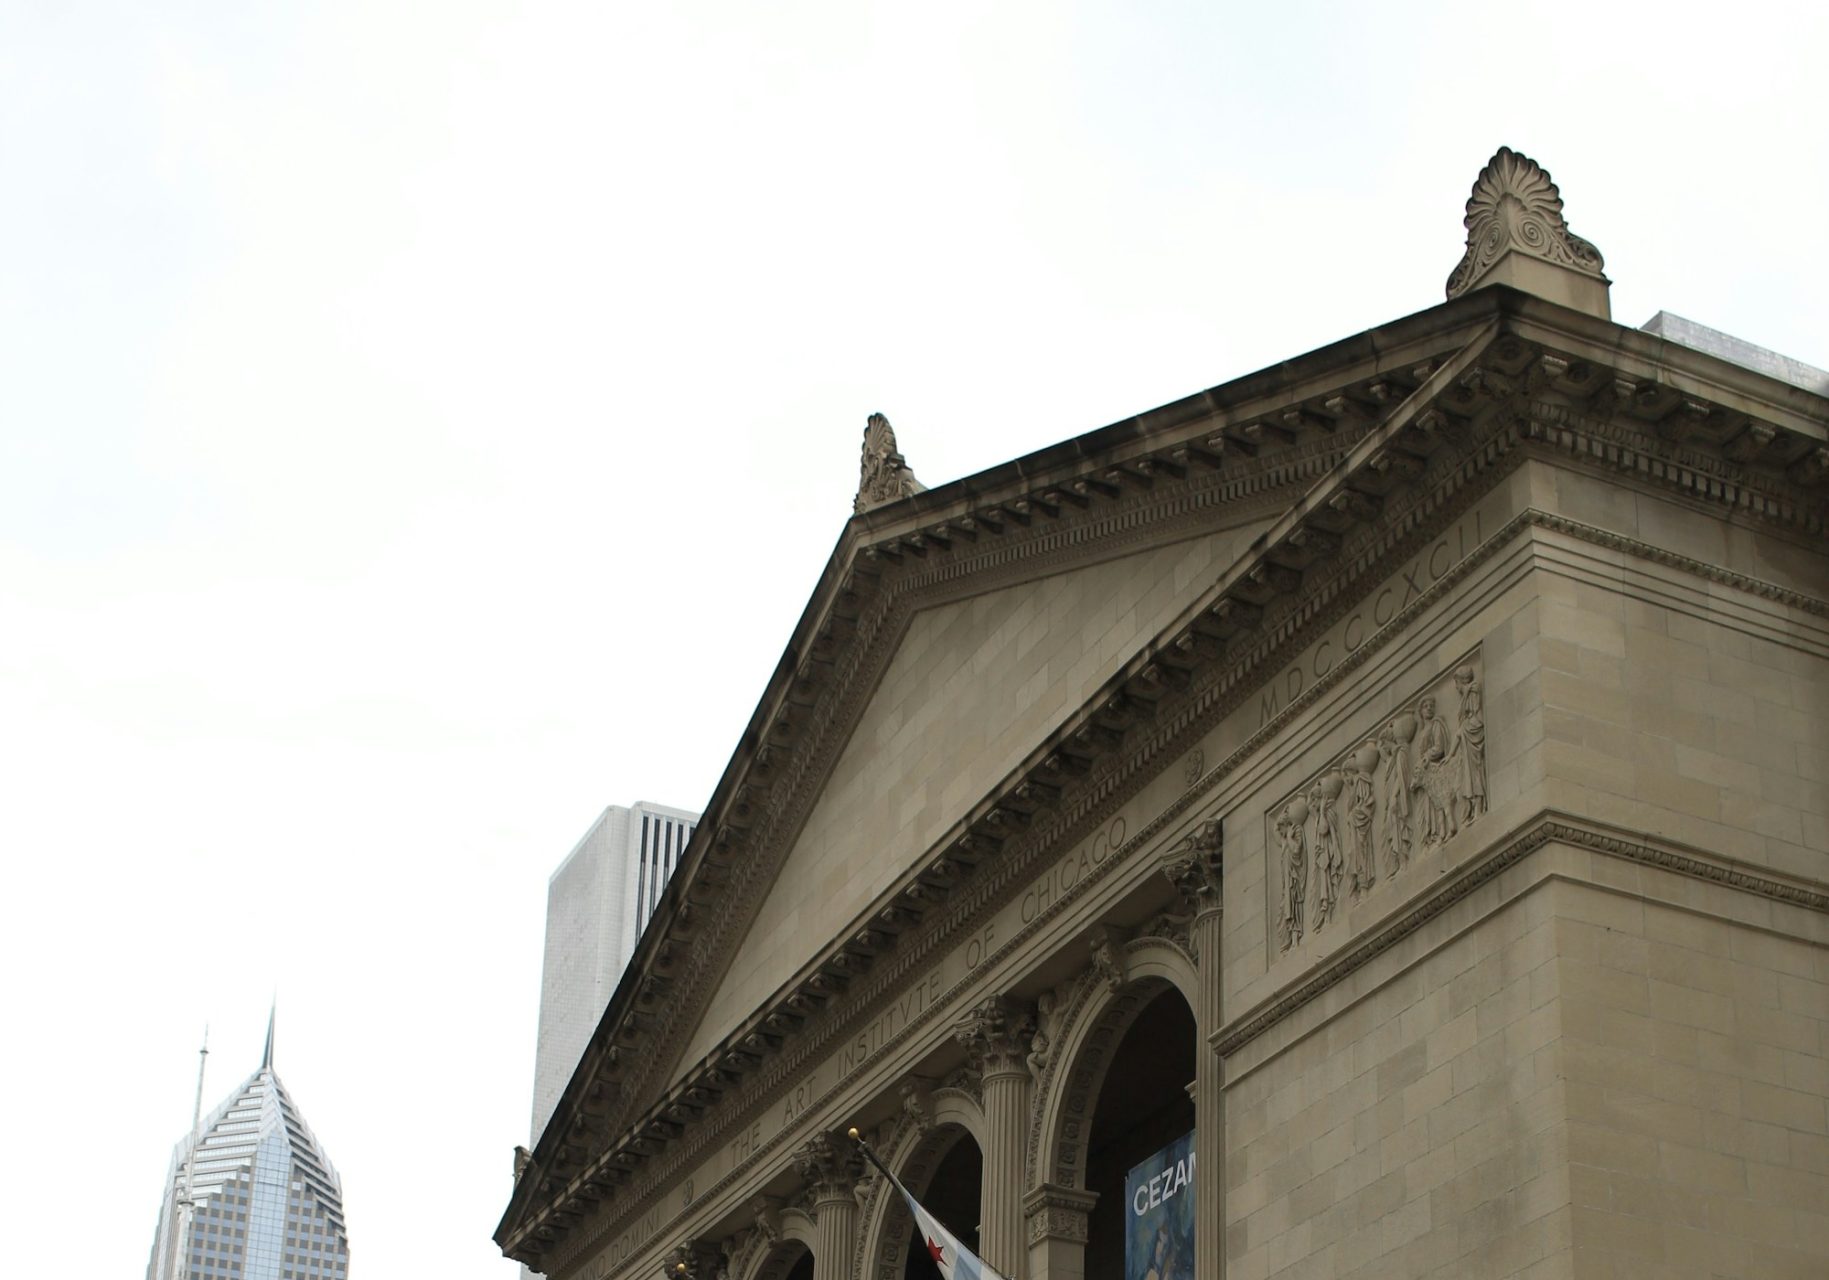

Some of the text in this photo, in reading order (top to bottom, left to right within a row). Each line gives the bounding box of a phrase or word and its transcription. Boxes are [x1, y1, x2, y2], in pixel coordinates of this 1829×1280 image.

[731, 1122, 761, 1169] THE
[784, 1076, 817, 1125] ART
[837, 973, 941, 1076] INSTITVTE
[965, 928, 995, 970] OF
[1020, 816, 1127, 926] CHICAGO
[1258, 510, 1483, 729] MDCCCXCII
